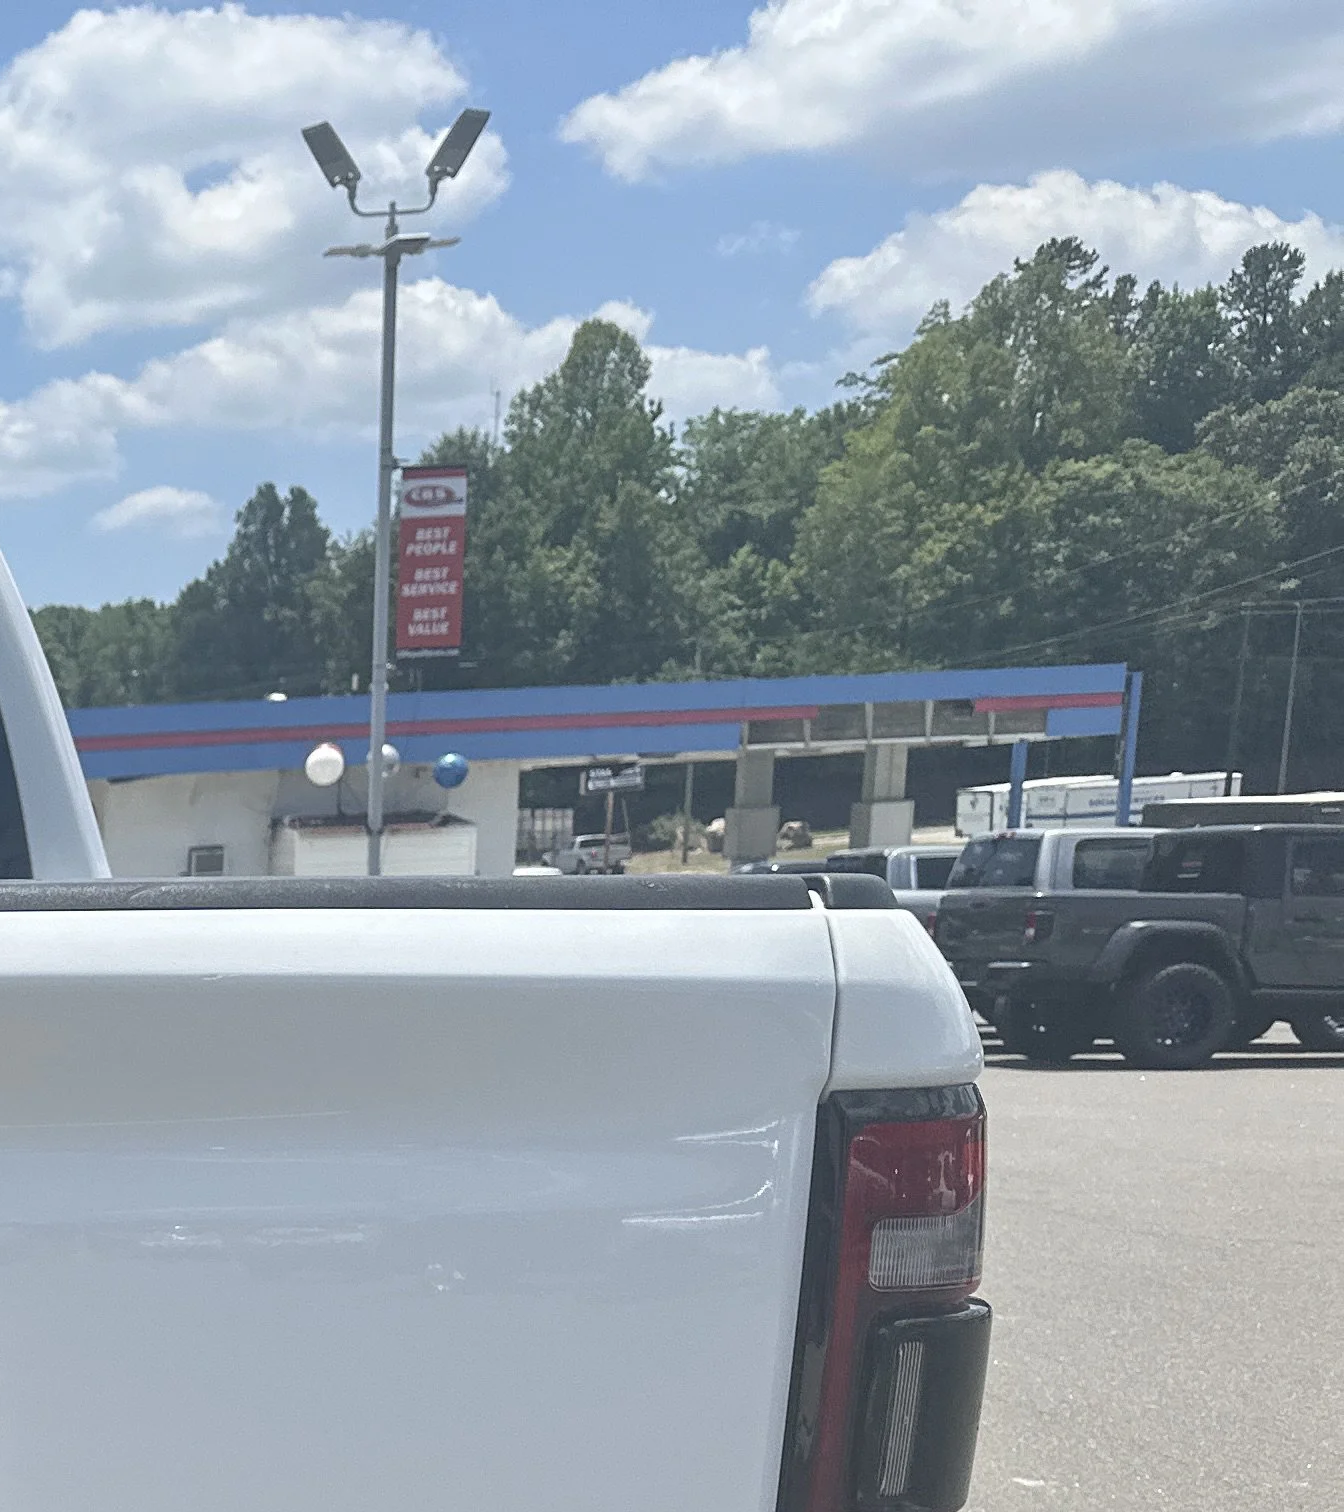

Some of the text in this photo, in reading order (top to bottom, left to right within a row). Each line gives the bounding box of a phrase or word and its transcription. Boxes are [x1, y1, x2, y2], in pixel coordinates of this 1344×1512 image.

[415, 526, 450, 541] BEST
[405, 540, 457, 557] PEOPLE
[414, 566, 449, 581] BEST
[401, 580, 458, 597] SERVICE
[413, 606, 447, 621] BEST
[407, 621, 449, 637] VALUE
